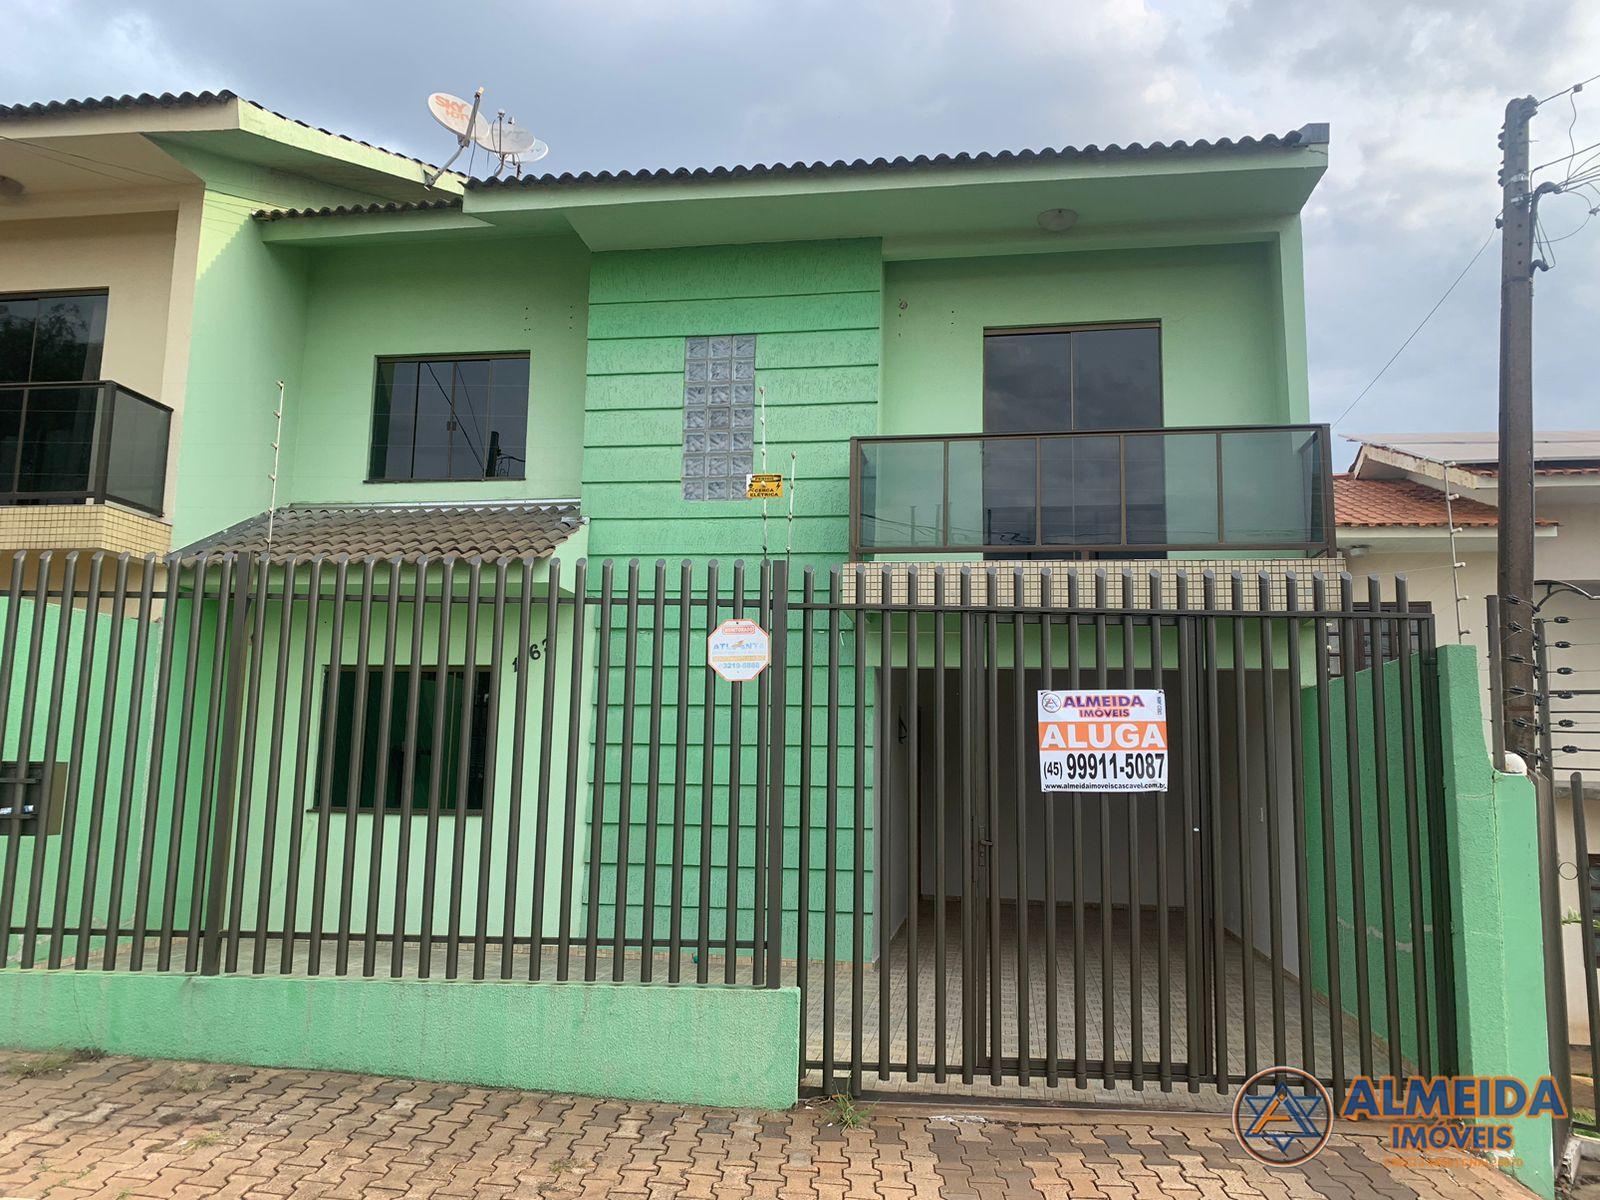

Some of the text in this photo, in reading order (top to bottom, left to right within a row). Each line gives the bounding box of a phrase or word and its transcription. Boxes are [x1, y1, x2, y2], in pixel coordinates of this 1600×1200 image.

[1063, 695, 1145, 708] ALMEIDA
[1079, 708, 1131, 718] IMÓVEIS
[1041, 723, 1166, 749] ALUGA
[1043, 753, 1165, 780] (45) 99911-5087
